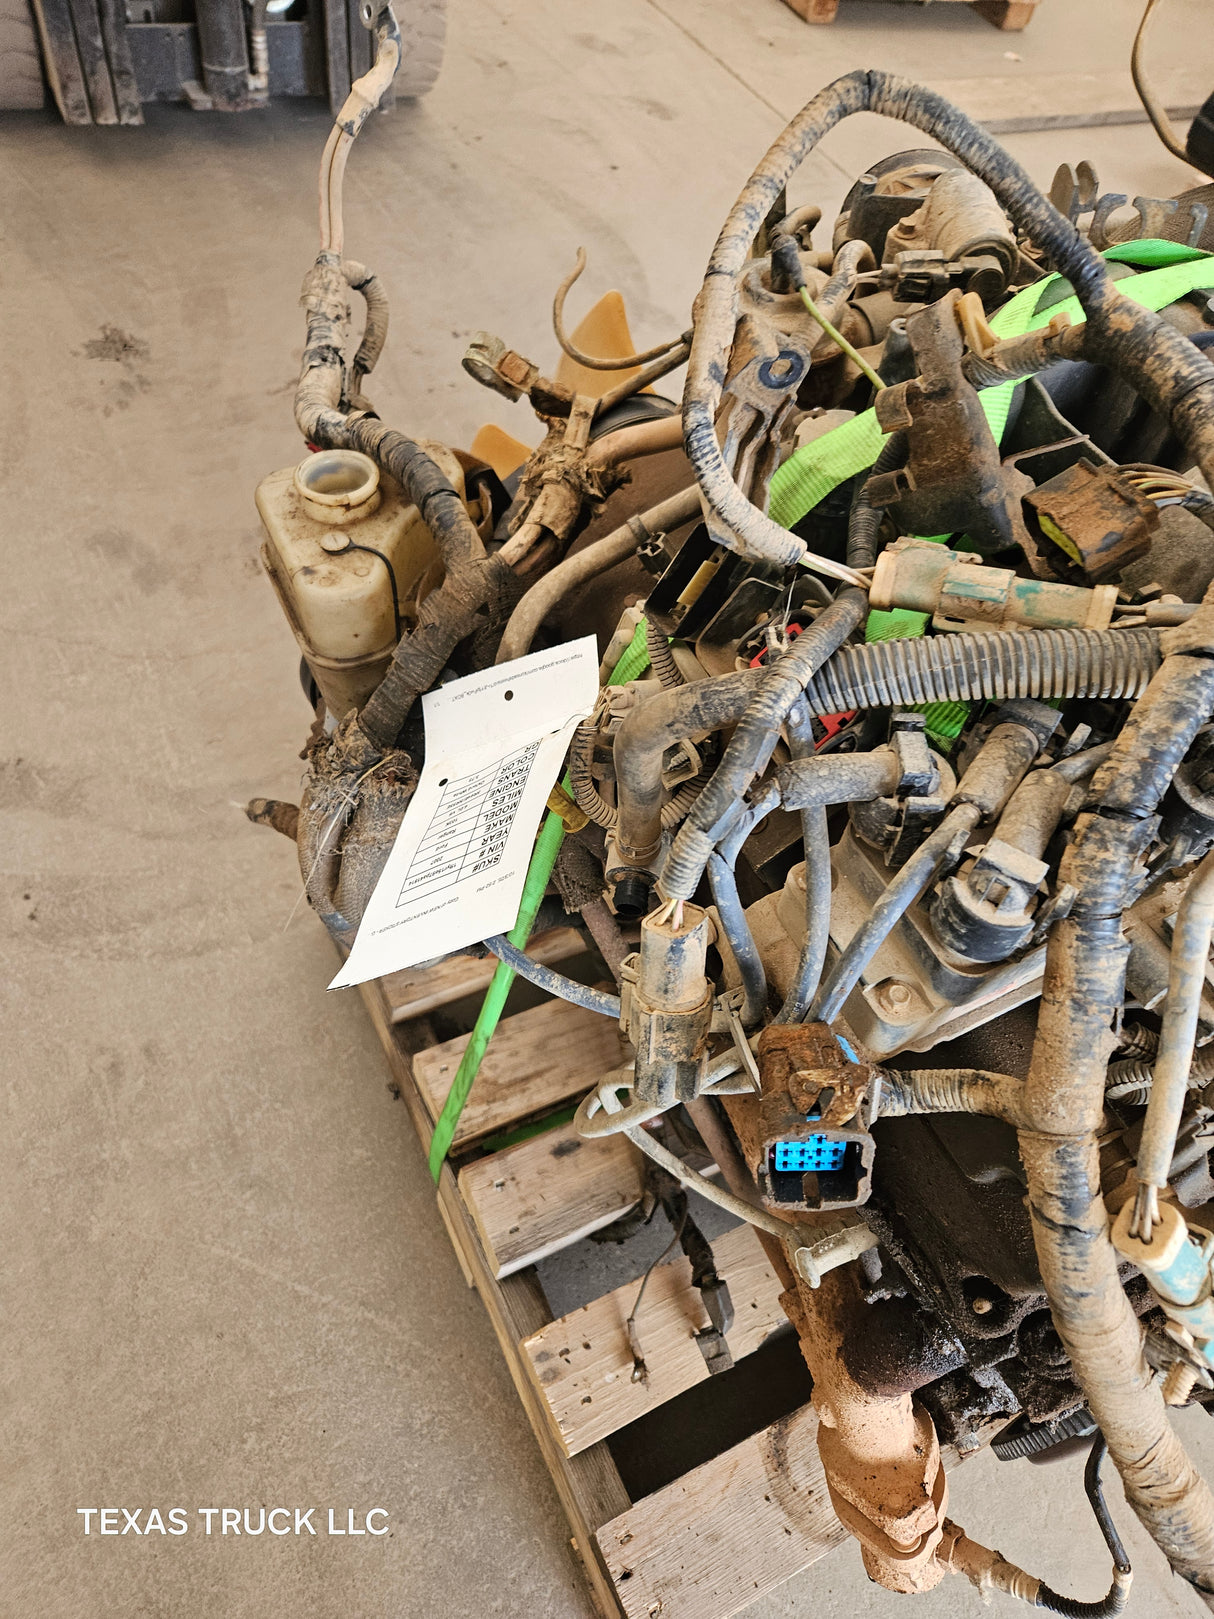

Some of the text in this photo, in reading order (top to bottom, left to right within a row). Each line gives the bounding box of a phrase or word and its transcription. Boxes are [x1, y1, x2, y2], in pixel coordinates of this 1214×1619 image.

[525, 742, 539, 752] GR
[501, 753, 534, 774] COLOR
[498, 764, 529, 784] TRANS
[489, 776, 526, 798] ENGINE
[492, 788, 522, 807] MILES
[437, 801, 518, 839] MODEL Ranger
[436, 813, 514, 851] MAKE Ford
[482, 828, 508, 845] YEAR
[479, 849, 486, 858] #
[488, 841, 503, 854] VIN
[472, 854, 500, 873] SKU#
